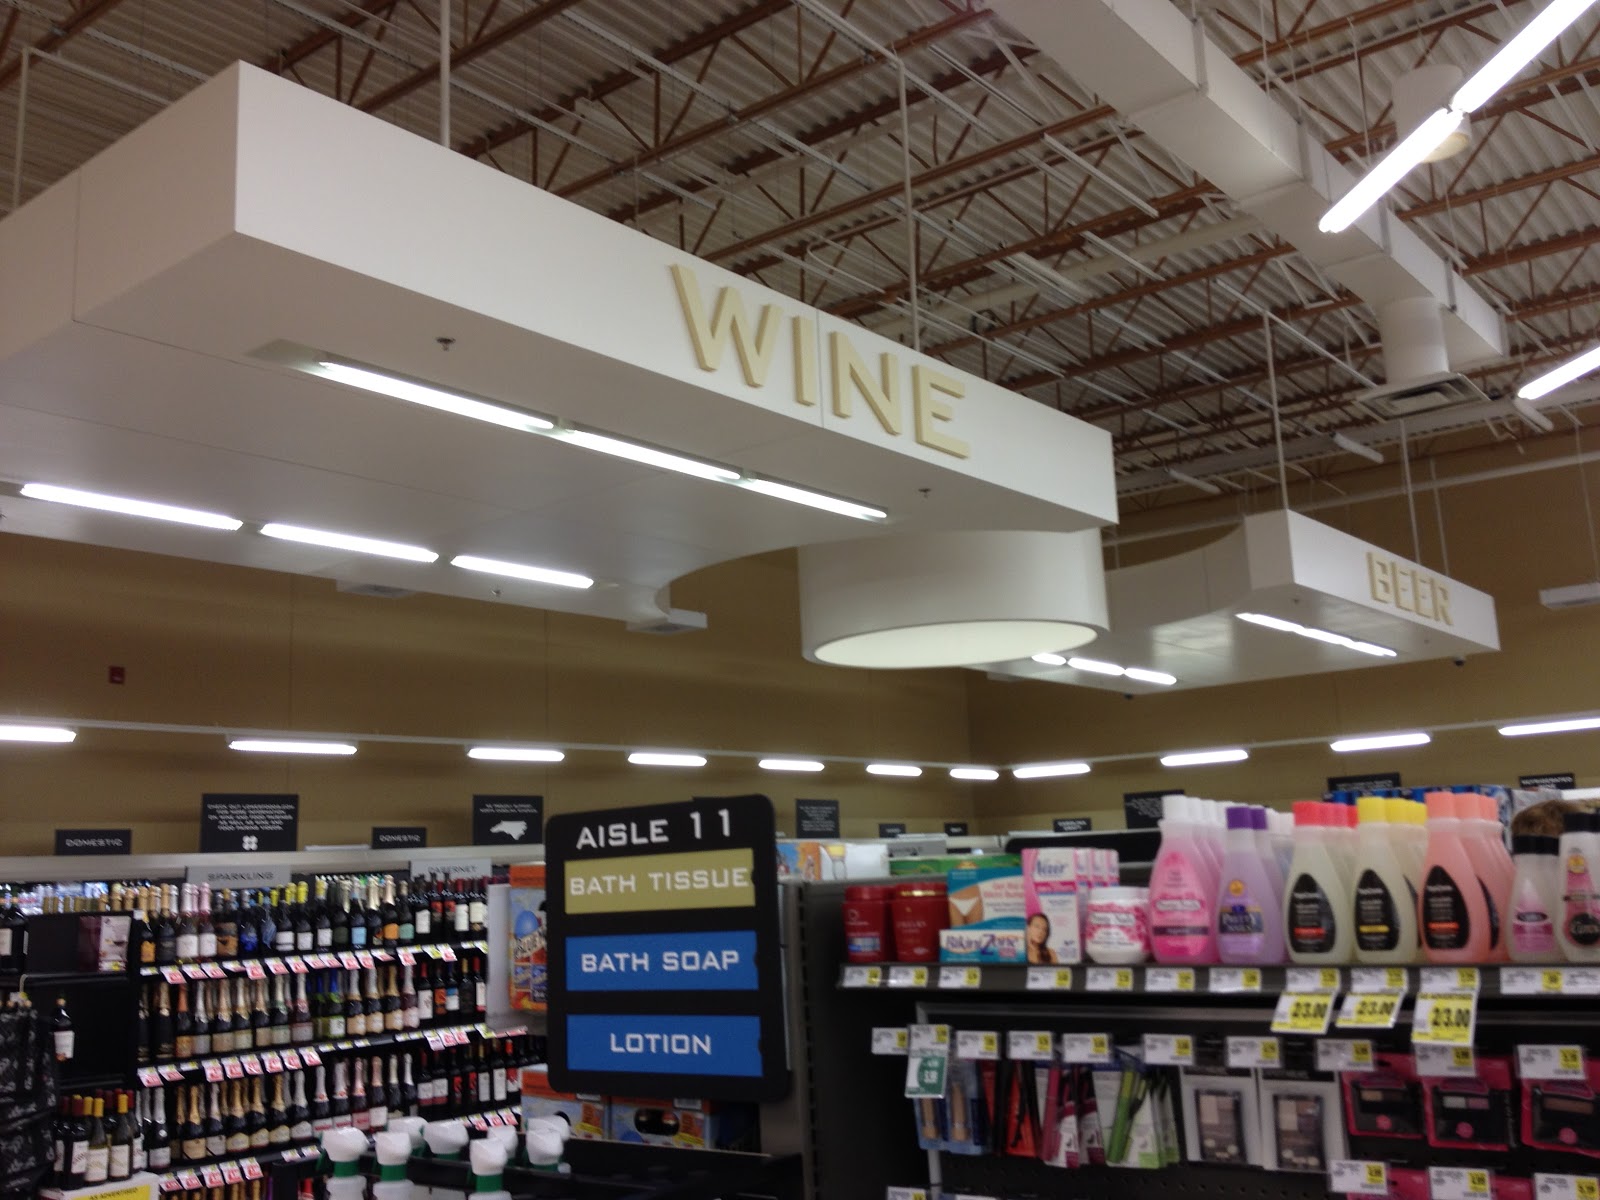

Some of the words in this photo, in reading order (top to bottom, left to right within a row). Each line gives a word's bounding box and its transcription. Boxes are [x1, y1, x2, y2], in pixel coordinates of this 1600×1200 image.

[671, 263, 971, 460] WINE
[1366, 551, 1454, 626] BEER
[65, 838, 124, 848] DOMESTIC
[379, 834, 421, 843] DOMESTIC
[575, 819, 670, 850] AISLE
[207, 872, 274, 881] SPARKLING
[569, 875, 637, 896] BATH
[648, 867, 750, 892] TISSUE
[580, 952, 649, 973] BATH
[661, 950, 740, 972] SOAP
[609, 1032, 712, 1055] LOTION
